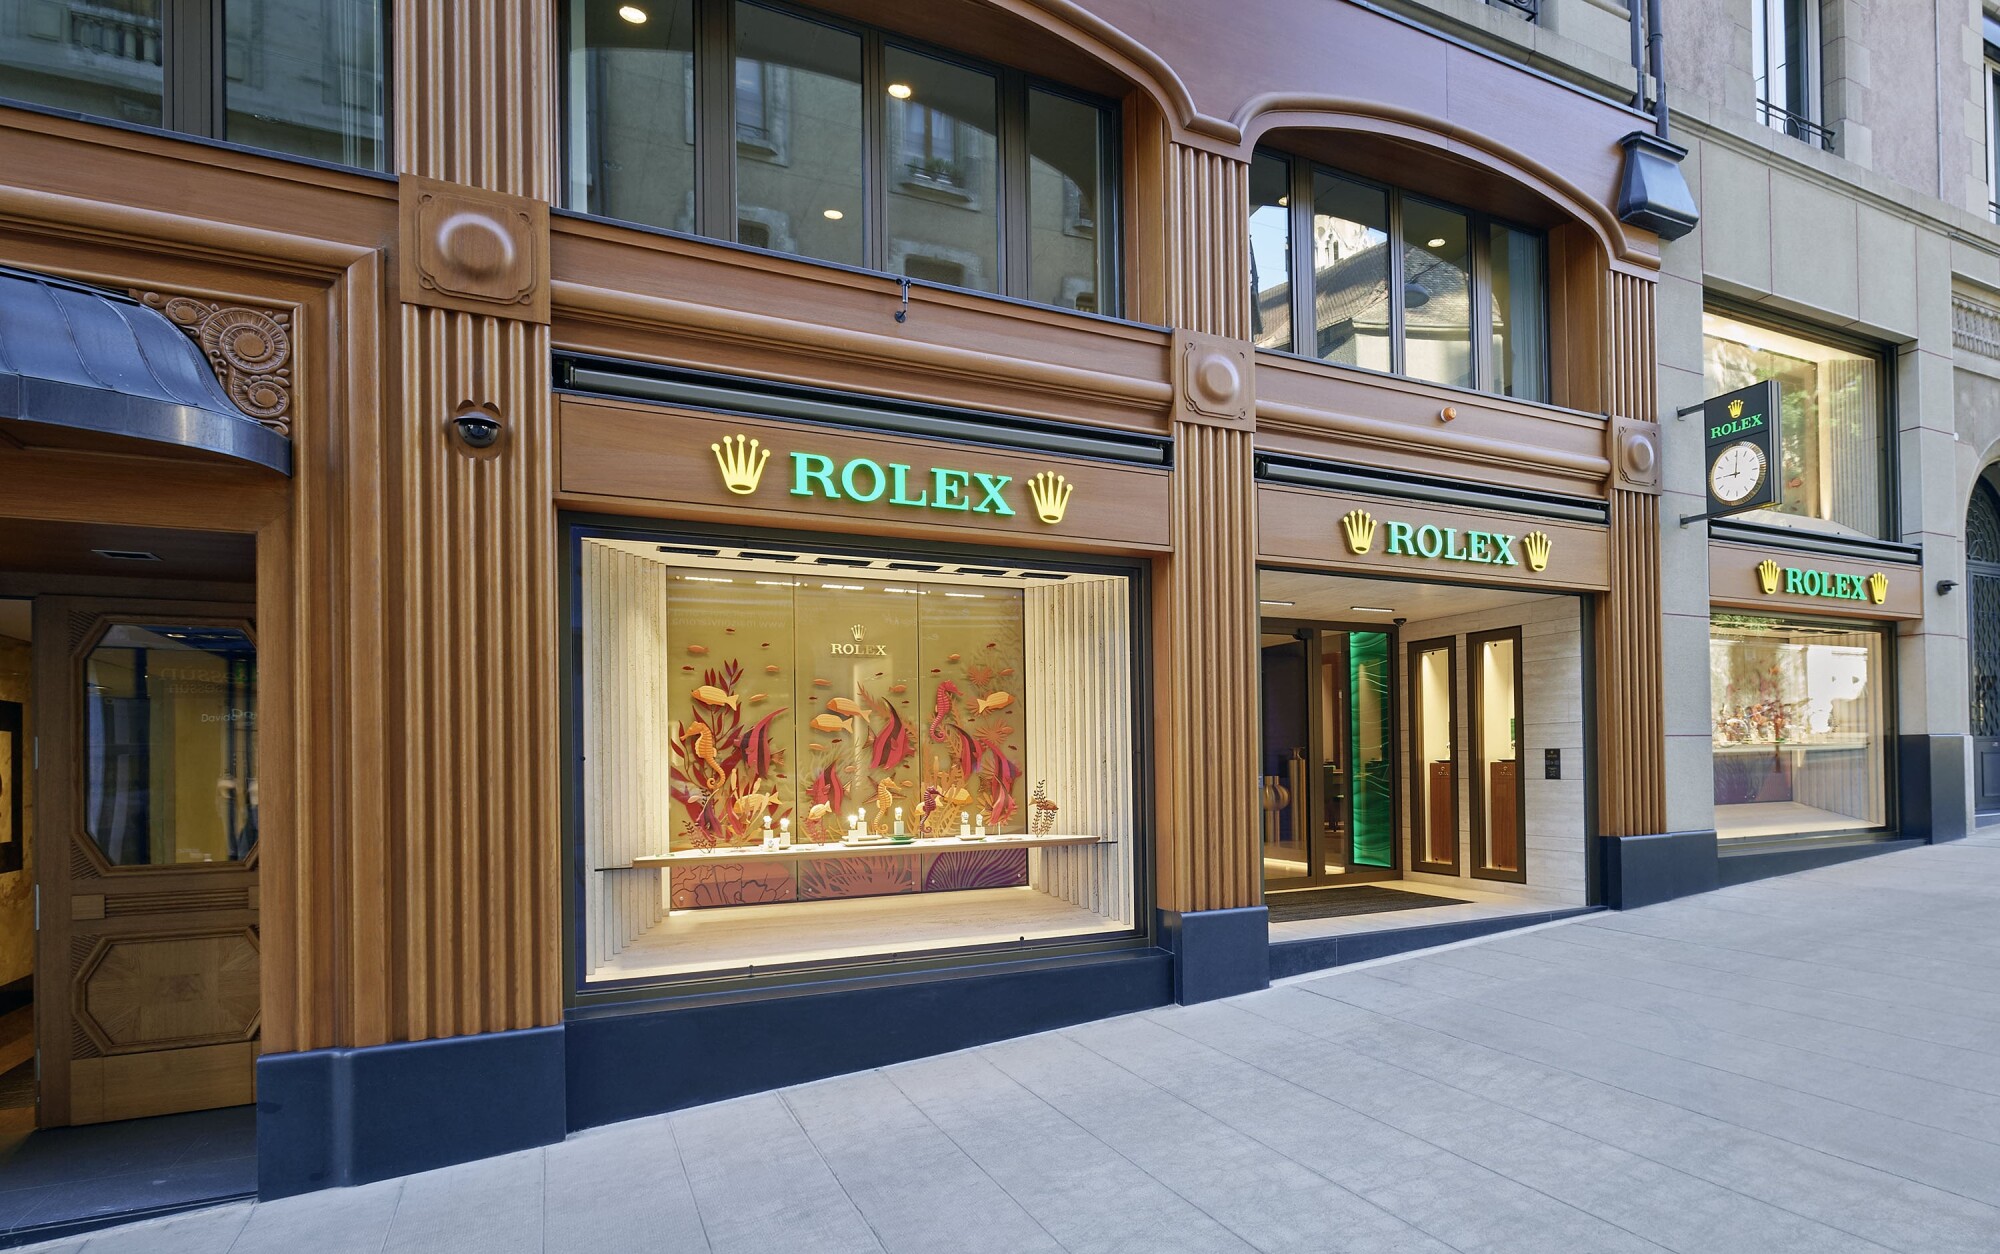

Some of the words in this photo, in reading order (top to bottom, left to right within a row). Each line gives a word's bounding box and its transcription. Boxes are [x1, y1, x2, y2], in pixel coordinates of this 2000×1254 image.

[1711, 413, 1763, 439] ROLEX
[789, 451, 1016, 516] ROLEX
[1386, 520, 1519, 566] ROLEX
[1785, 567, 1868, 601] ROLEX
[830, 643, 888, 656] ROLEX
